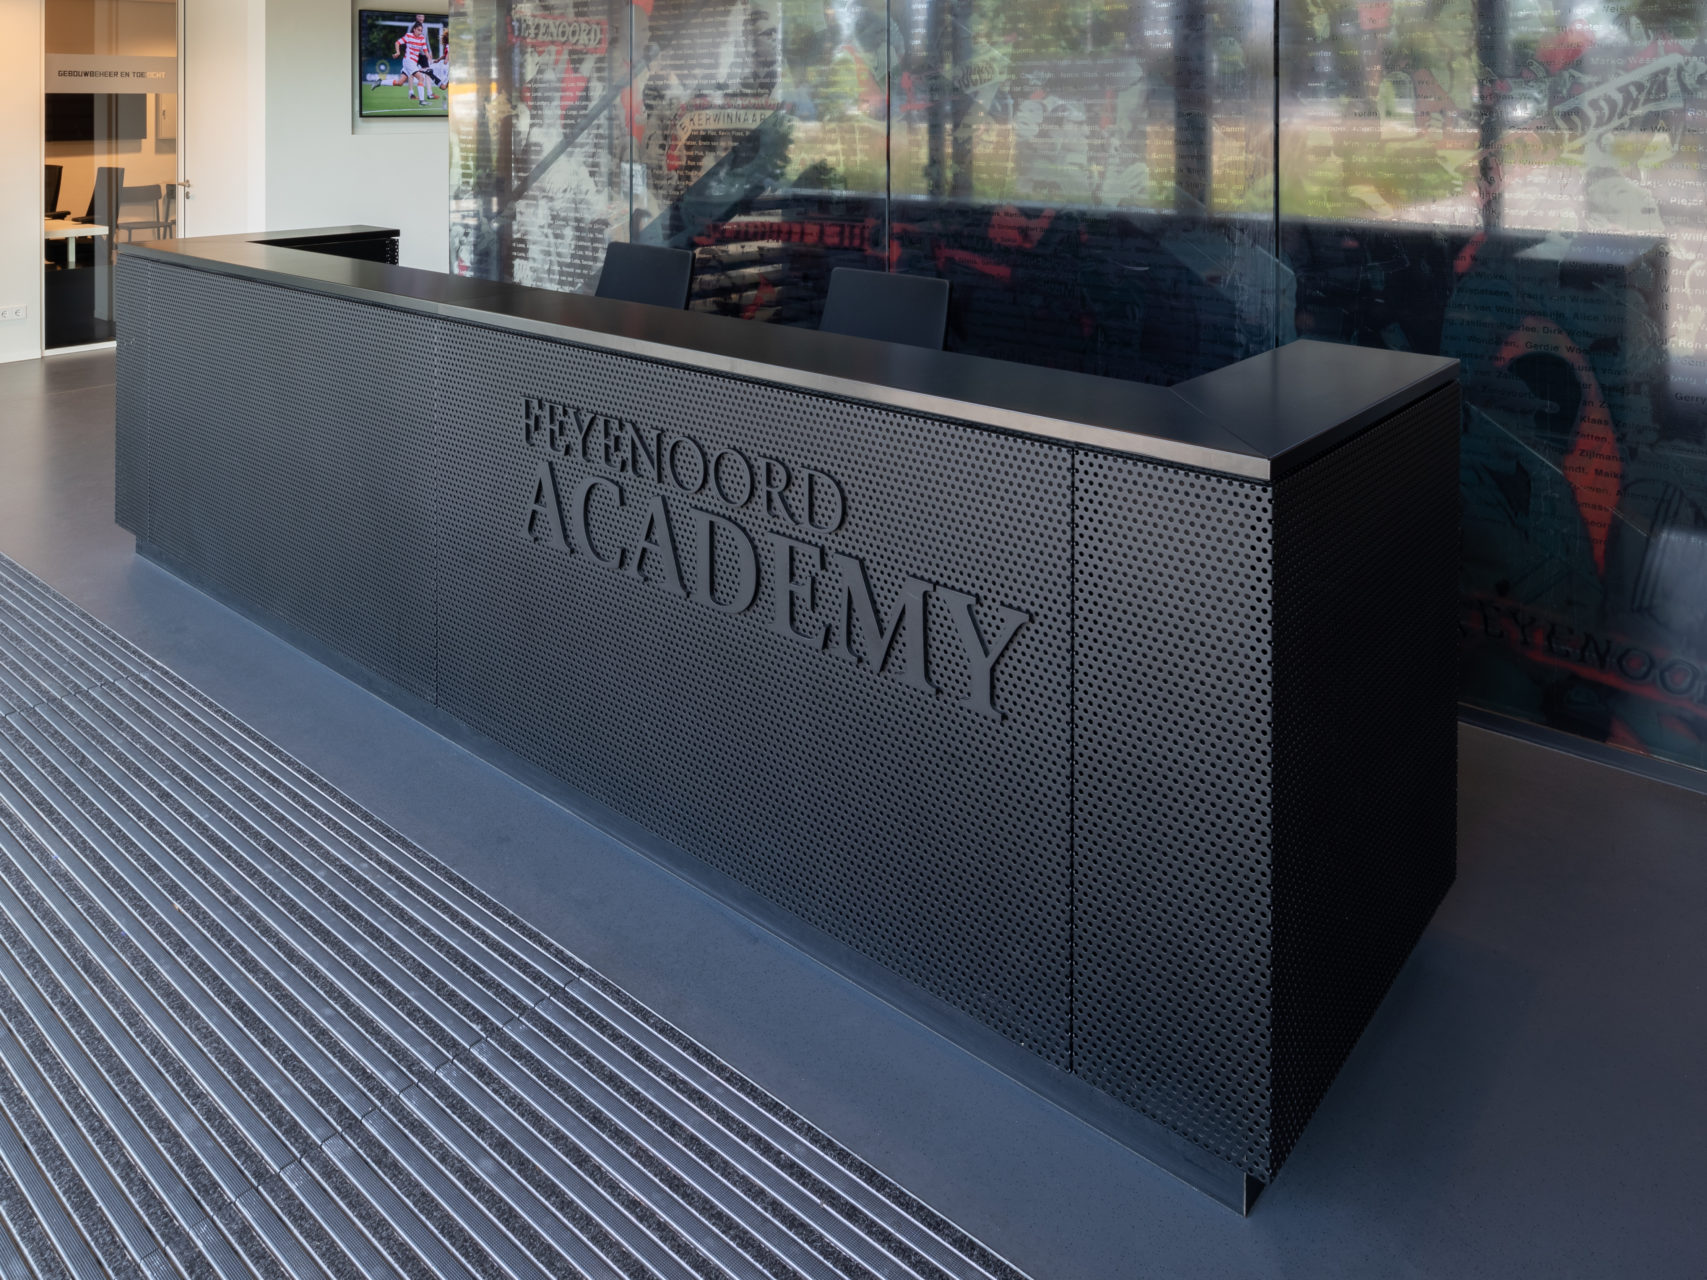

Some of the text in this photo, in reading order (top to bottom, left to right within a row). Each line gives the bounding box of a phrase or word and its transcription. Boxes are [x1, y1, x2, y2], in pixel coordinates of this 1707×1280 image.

[58, 70, 119, 78] GEBOUWBEHEER
[120, 71, 130, 79] EN
[522, 398, 848, 534] FEYENOORD
[526, 462, 1031, 722] ACADEMY
